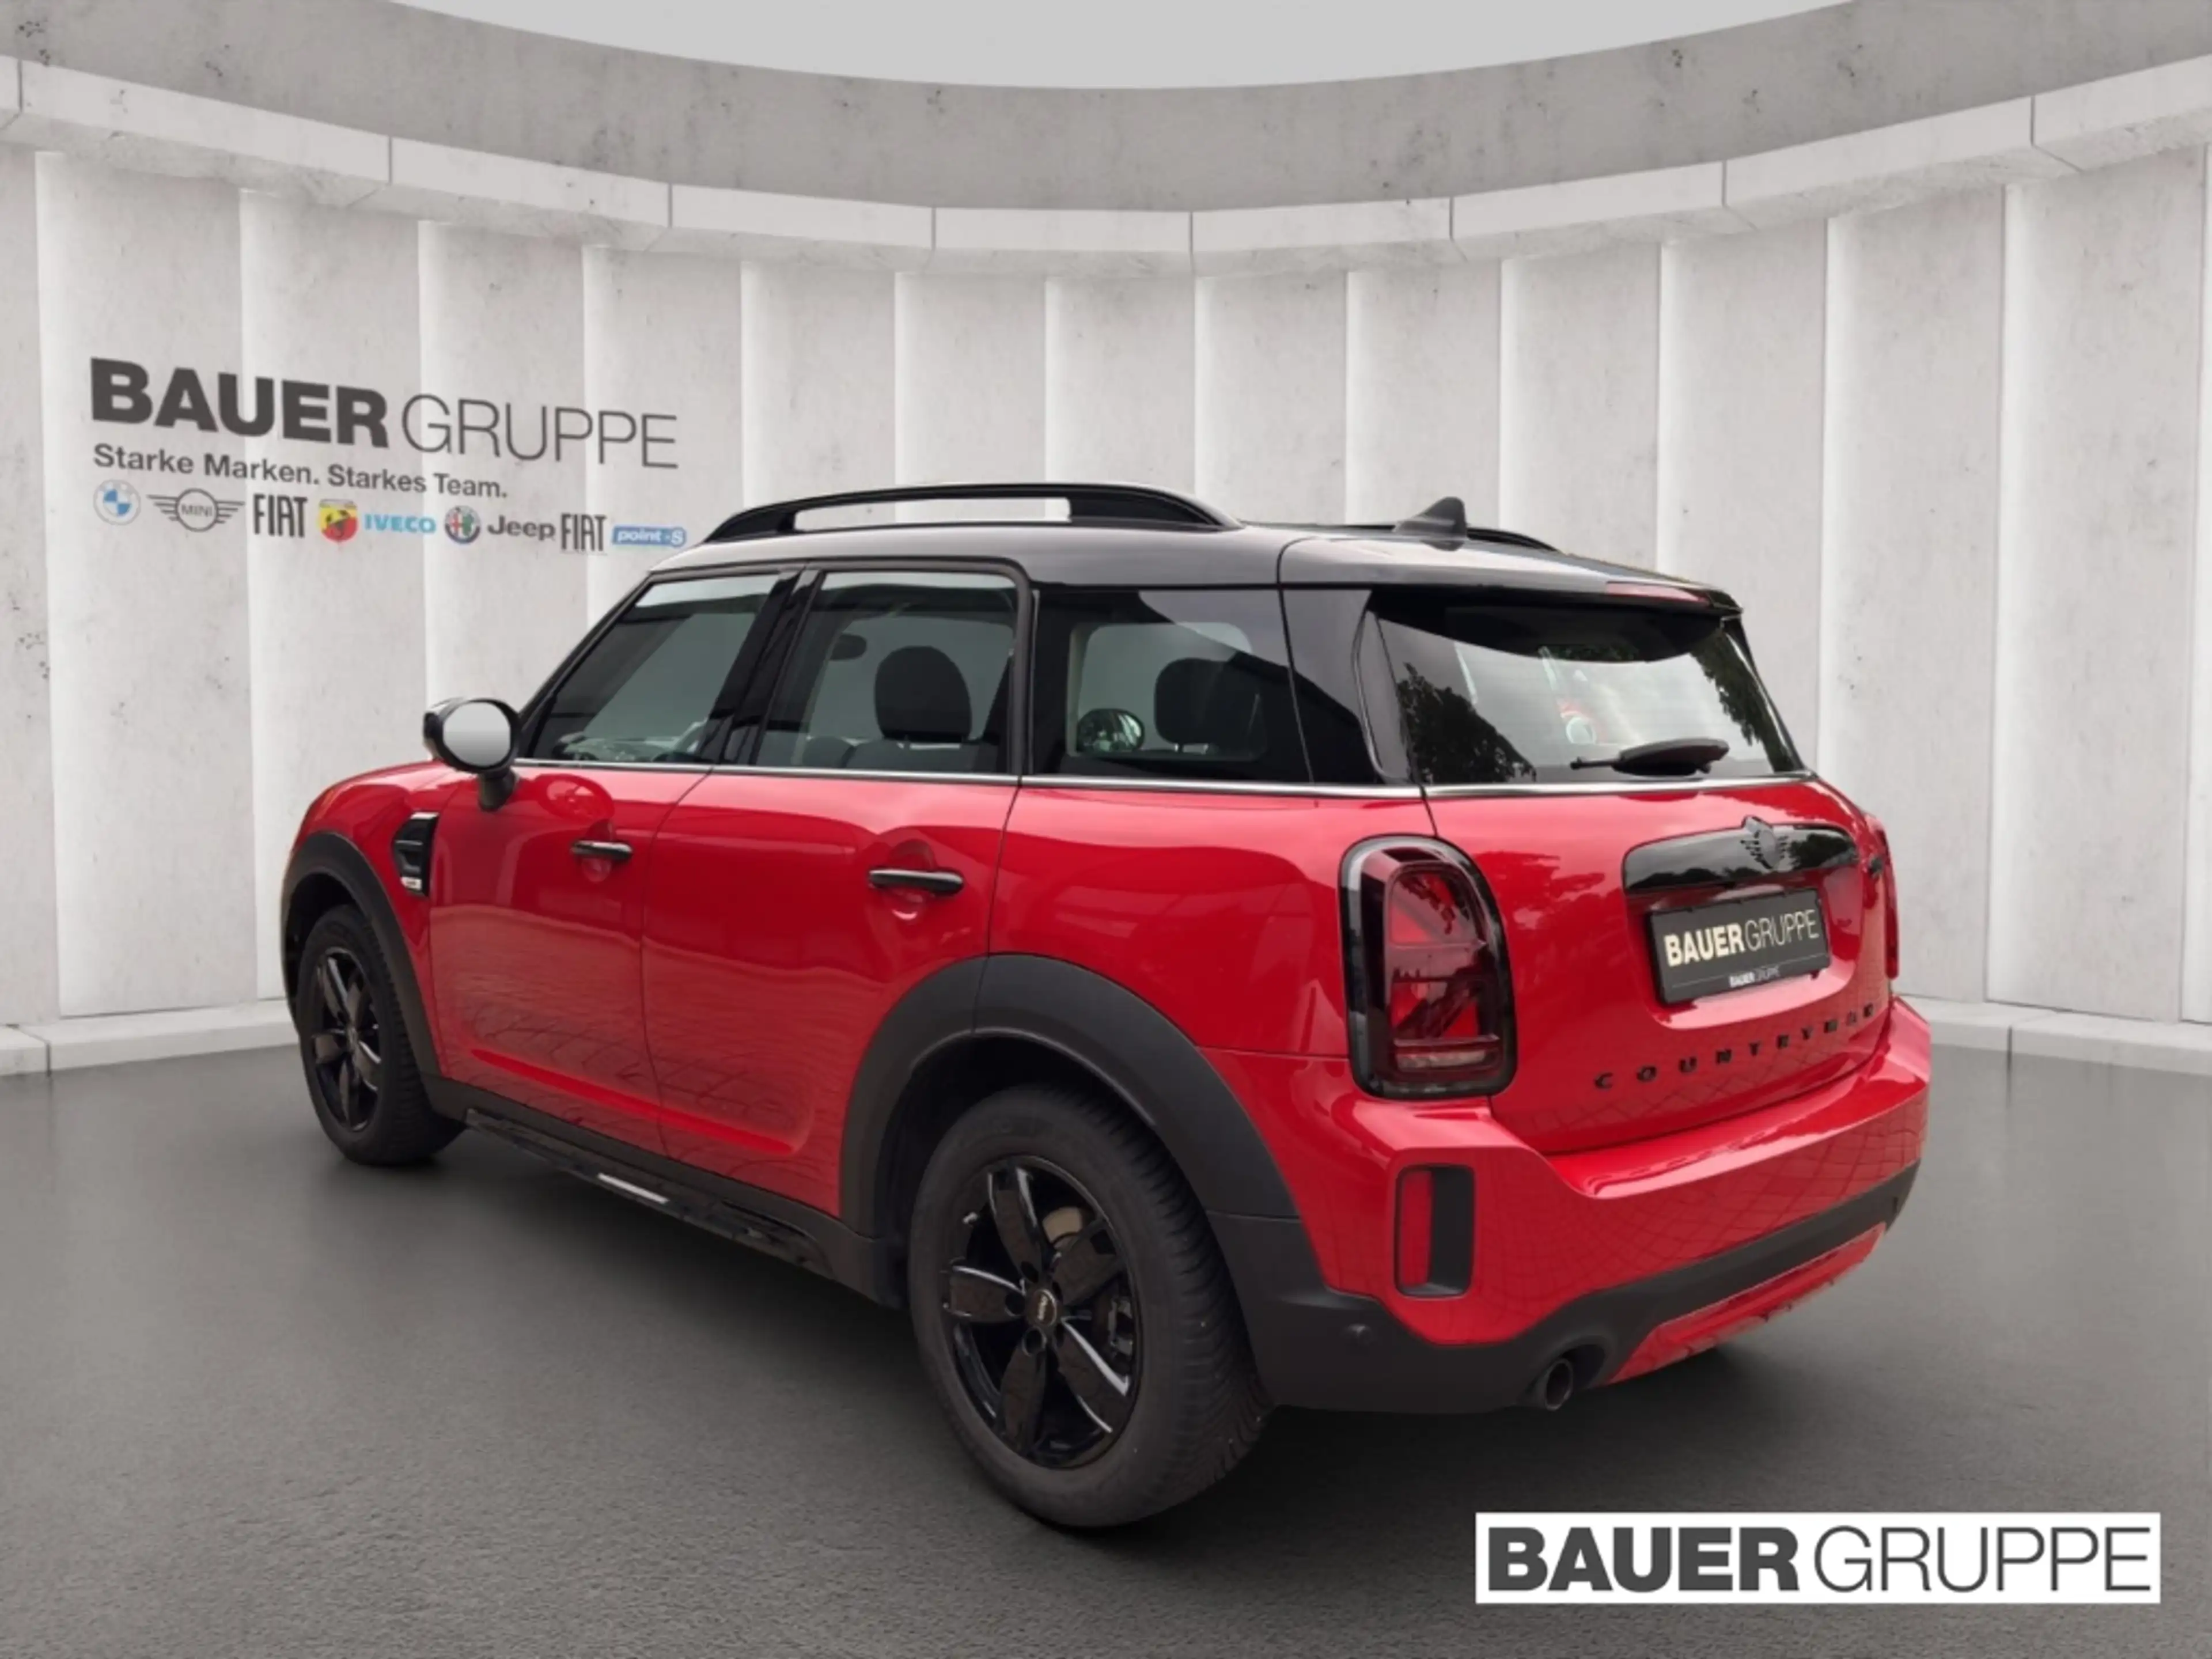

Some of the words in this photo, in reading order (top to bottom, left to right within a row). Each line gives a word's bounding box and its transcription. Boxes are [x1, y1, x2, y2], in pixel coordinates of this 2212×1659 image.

[93, 444, 194, 474] Starke
[204, 454, 319, 484] Marken.
[327, 464, 426, 493] Starkes
[434, 473, 507, 498] Team.
[253, 494, 308, 538] FIAT
[364, 514, 437, 533] IVECO
[487, 515, 556, 540] Jeep
[561, 513, 607, 551] FIAT
